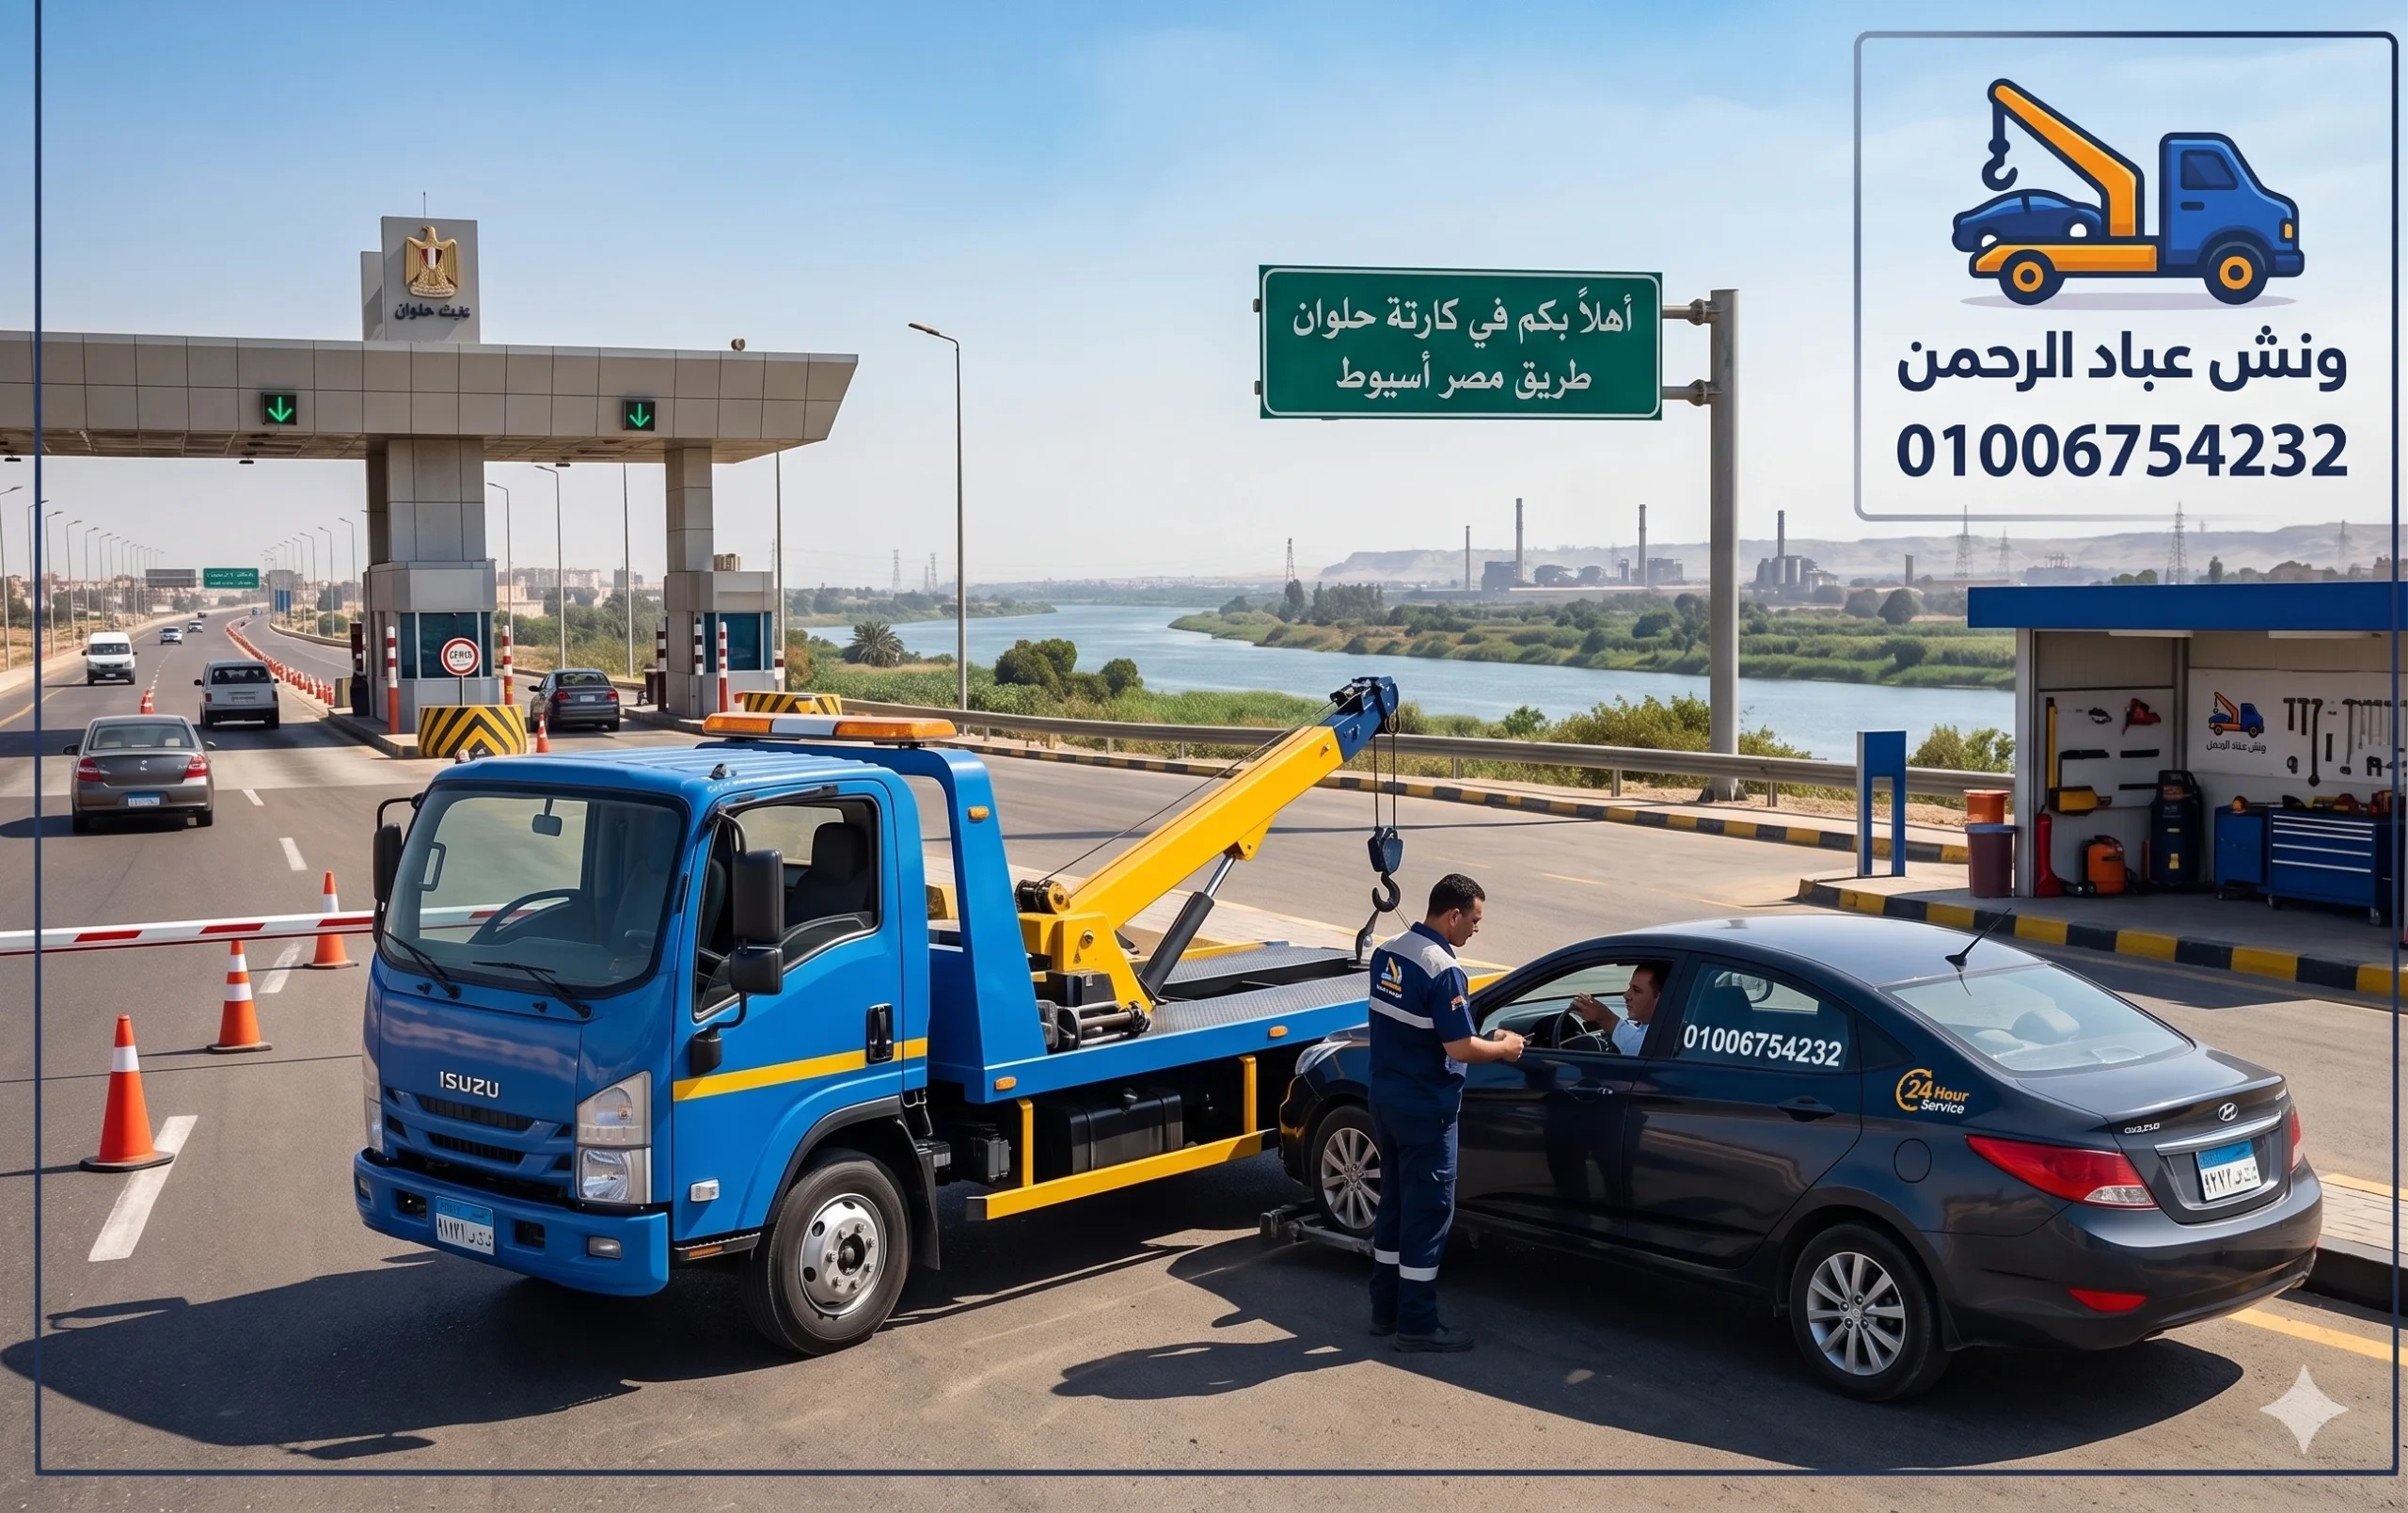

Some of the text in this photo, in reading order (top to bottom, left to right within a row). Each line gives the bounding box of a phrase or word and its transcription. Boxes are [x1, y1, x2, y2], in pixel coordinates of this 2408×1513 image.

[1293, 286, 1632, 349] أهلاً بكم في كارتة حلوان
[1336, 350, 1592, 400] طريق مصر أسيوط
[1684, 1025, 1842, 1067] 01006754232
[439, 1071, 499, 1099] ISUZU
[1905, 1079, 1970, 1102] 24 Hour
[1921, 1099, 1965, 1114] Service
